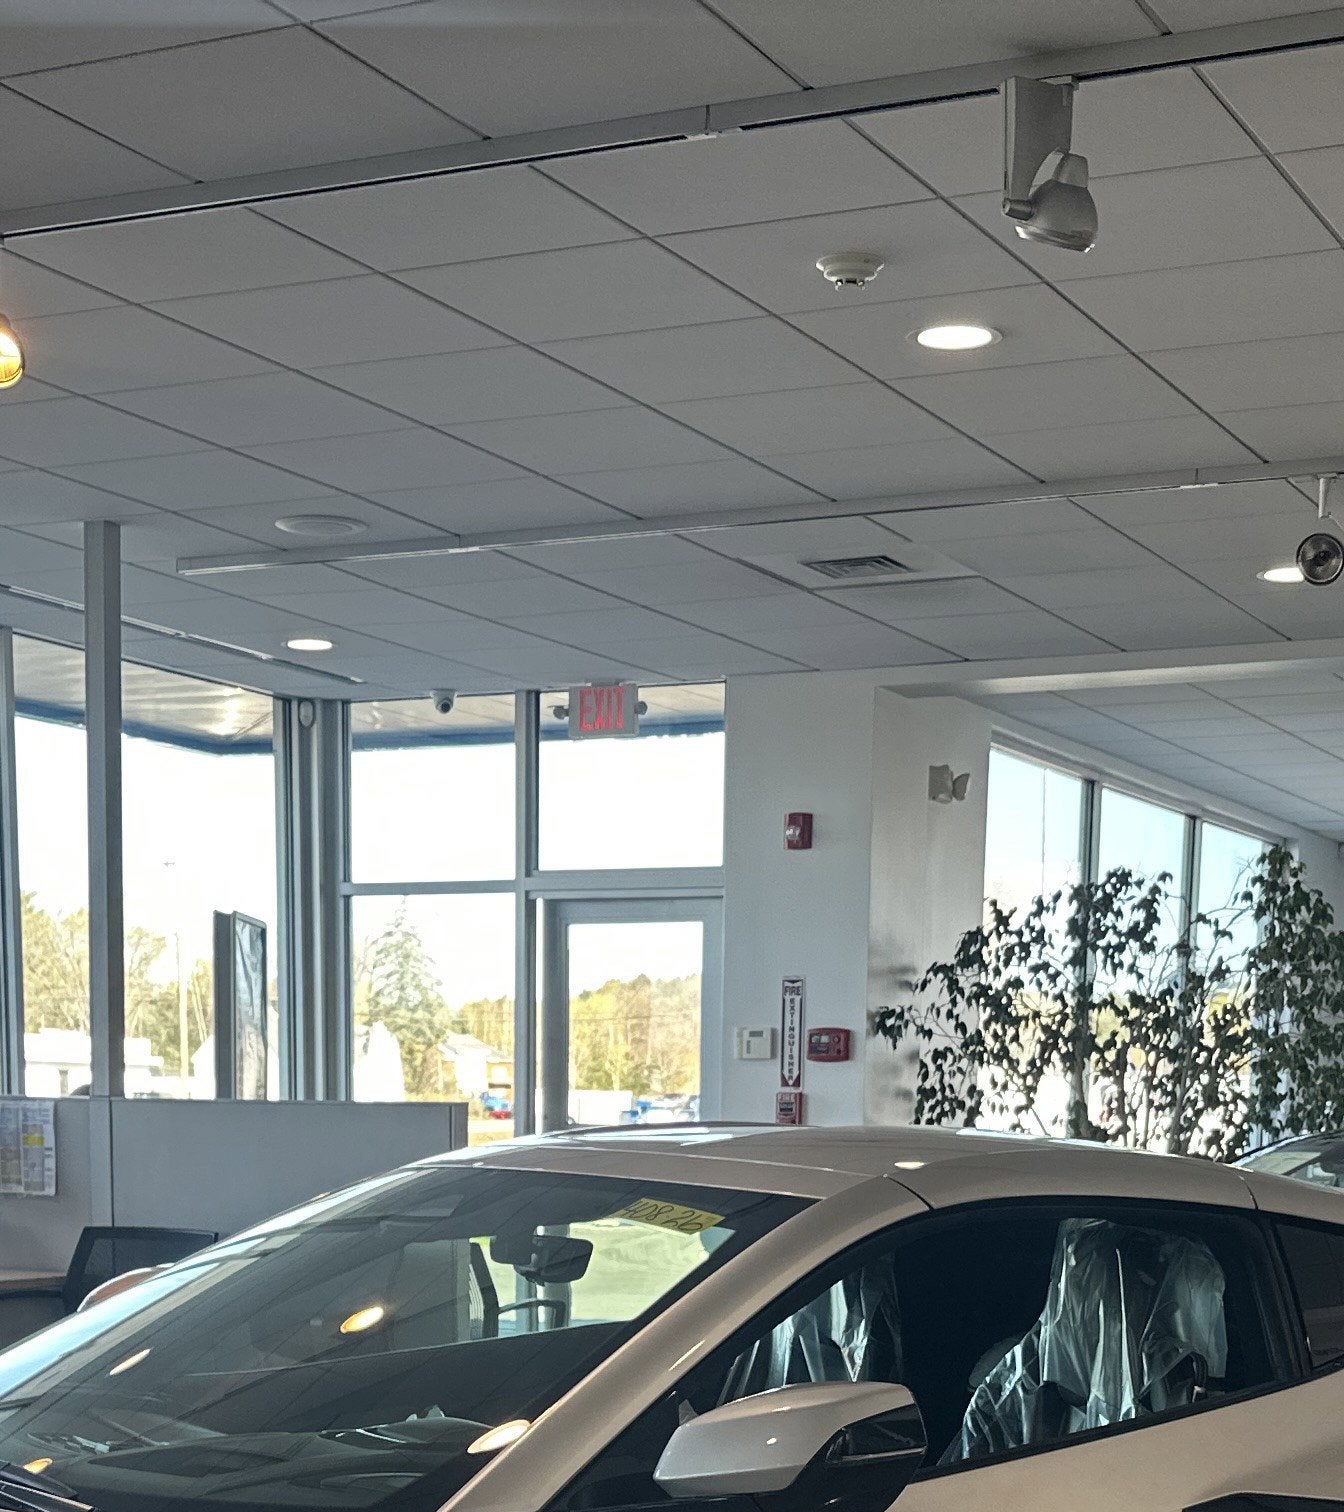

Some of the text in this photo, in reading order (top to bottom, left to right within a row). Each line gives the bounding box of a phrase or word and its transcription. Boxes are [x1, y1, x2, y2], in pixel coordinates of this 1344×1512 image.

[580, 687, 624, 731] EXIT
[784, 985, 801, 996] FIRE
[787, 998, 796, 1081] EXTINGUISHER
